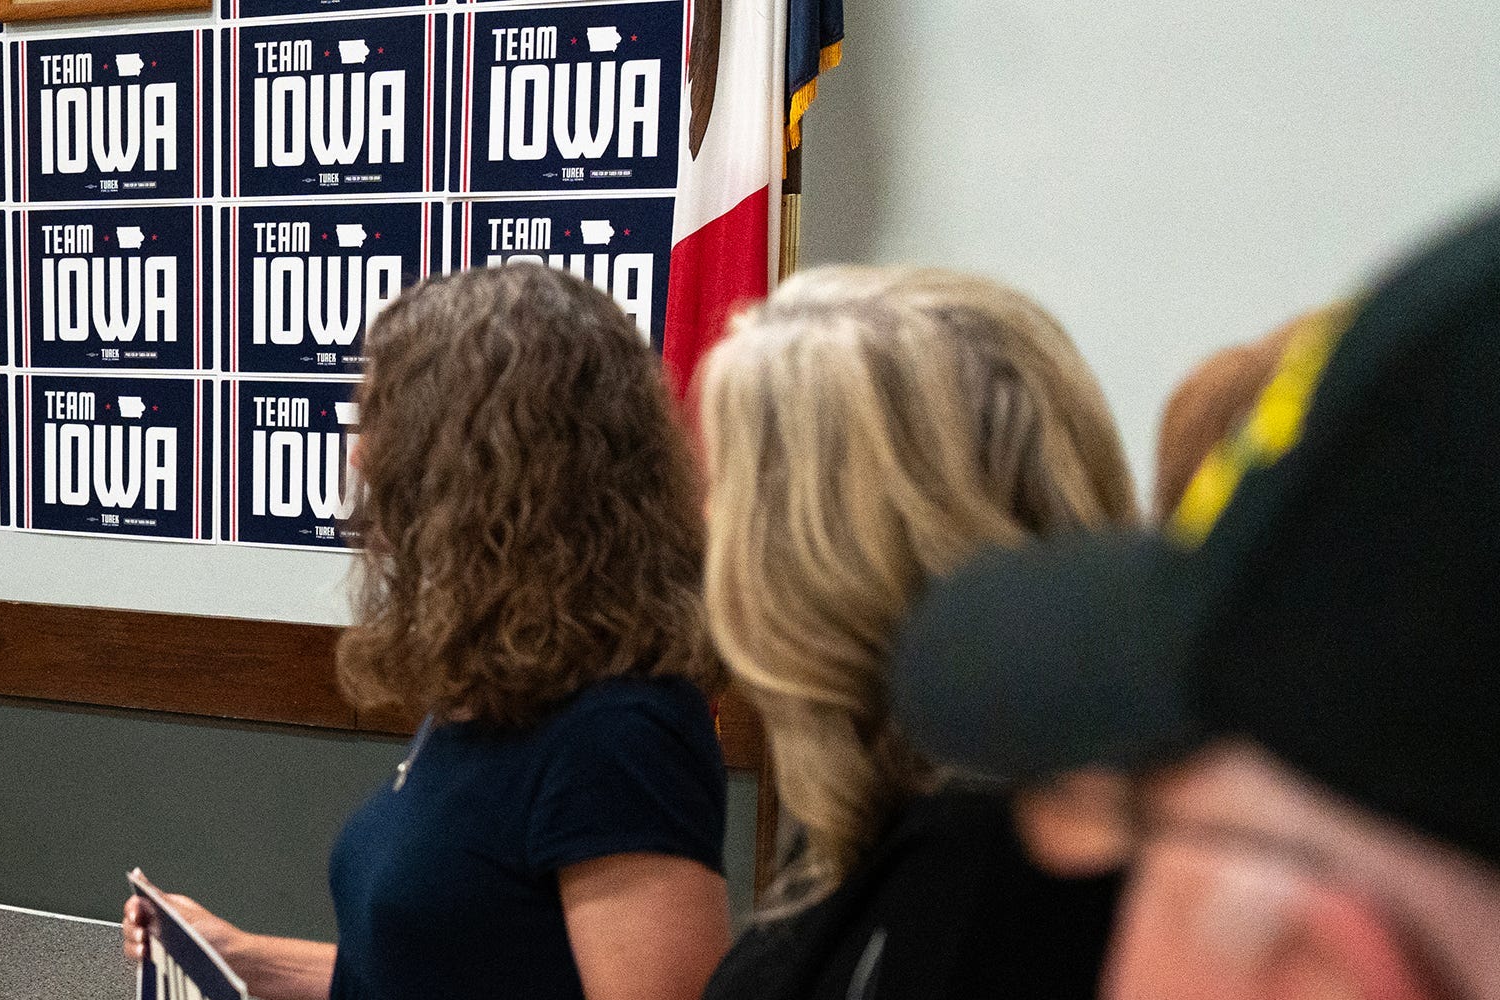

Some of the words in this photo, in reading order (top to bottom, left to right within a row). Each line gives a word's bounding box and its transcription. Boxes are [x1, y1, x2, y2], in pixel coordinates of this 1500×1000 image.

[254, 39, 313, 73] TEAM
[491, 26, 558, 61] TEAM
[40, 53, 93, 85] TEAM
[253, 70, 406, 168] IOWA
[488, 59, 661, 162] IOWA
[40, 83, 177, 175] IOWA
[41, 225, 94, 254] TEAM
[254, 222, 311, 253] TEAM
[488, 217, 551, 251] TEAM
[42, 256, 178, 342] IOWA
[44, 391, 96, 421] TEAM
[253, 397, 310, 428] TEAM
[44, 423, 178, 511] IOWA
[252, 430, 362, 520] IOW
